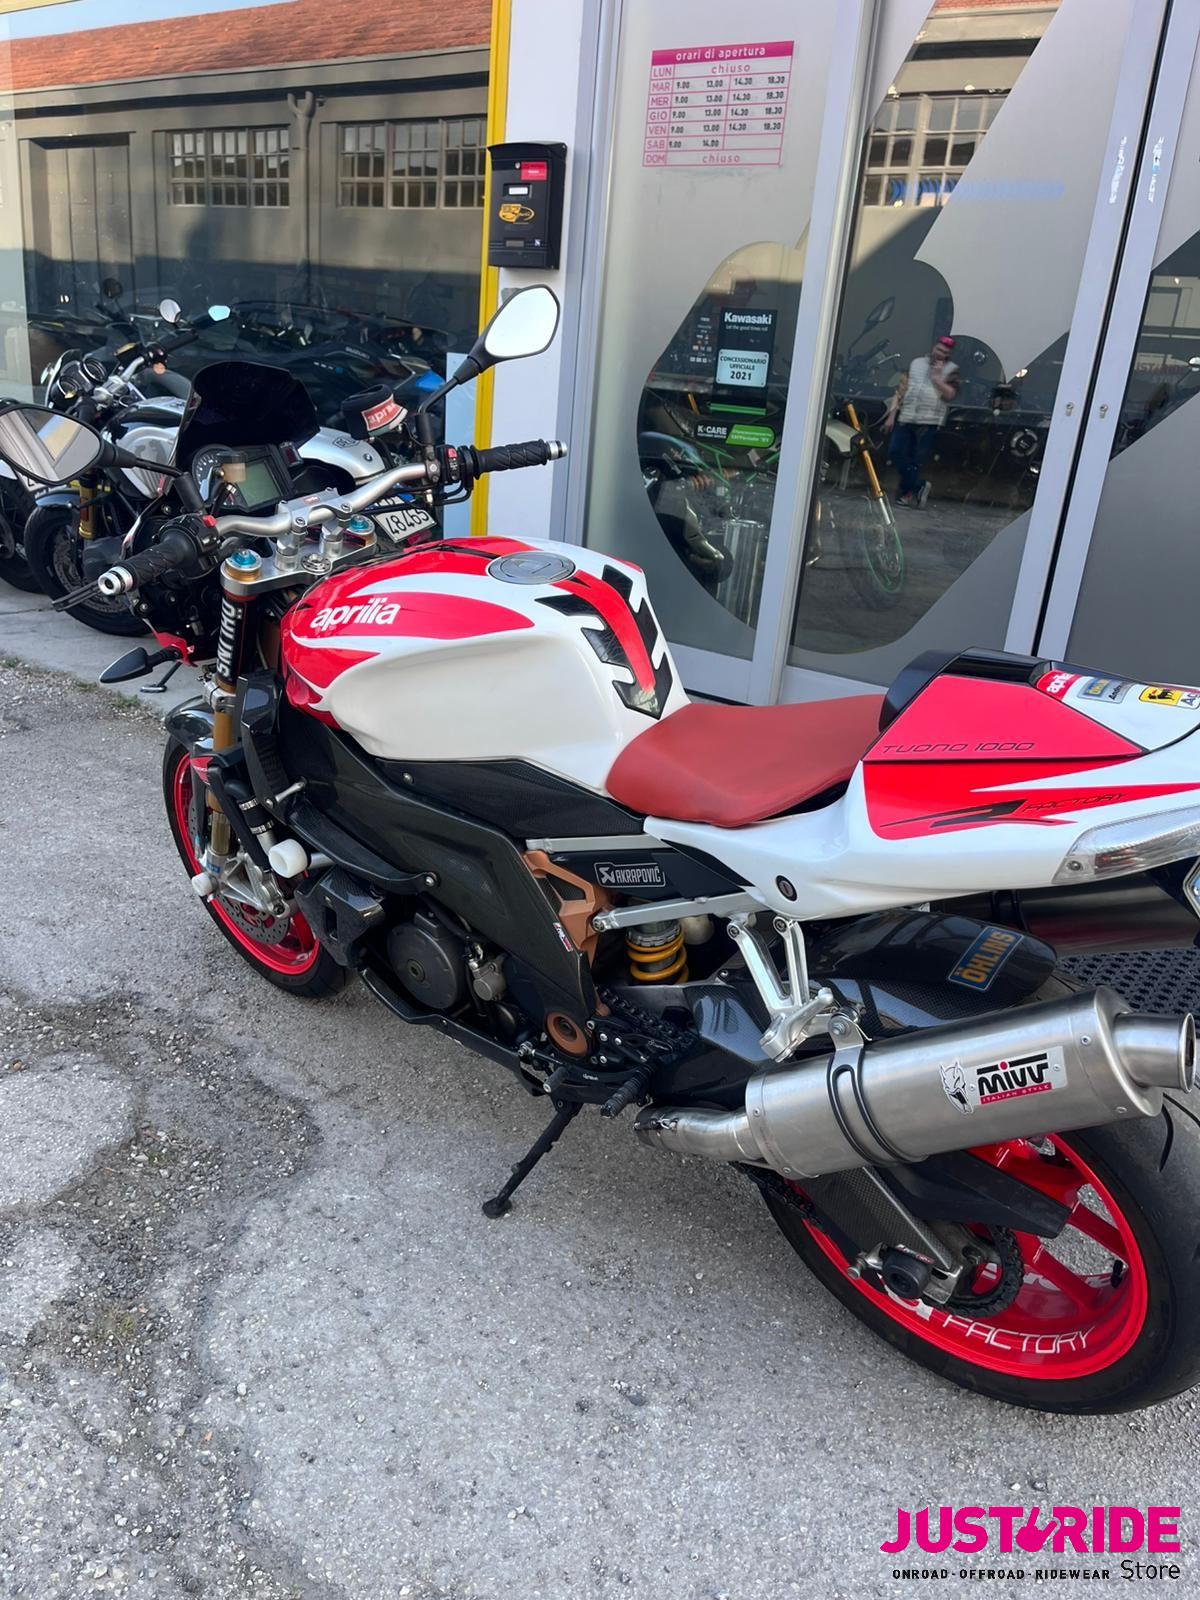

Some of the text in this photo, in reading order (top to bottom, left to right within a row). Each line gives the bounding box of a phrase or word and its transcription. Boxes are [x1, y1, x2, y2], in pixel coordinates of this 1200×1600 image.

[675, 46, 766, 61] orari di apertura
[653, 63, 751, 77] LUN chiuso
[652, 82, 671, 91] MAR
[650, 97, 669, 106] MER
[650, 111, 668, 121] GIO
[648, 125, 667, 135] VEN
[647, 139, 665, 149] SAB
[646, 153, 741, 164] DOM chiuso
[724, 312, 772, 325] Kawasaki
[730, 371, 752, 380] 2021
[309, 597, 401, 632] aprilia
[883, 742, 1035, 754] TUONO 1000
[1022, 793, 1126, 812] FACTORY
[942, 1314, 1096, 1355] FACTORY
